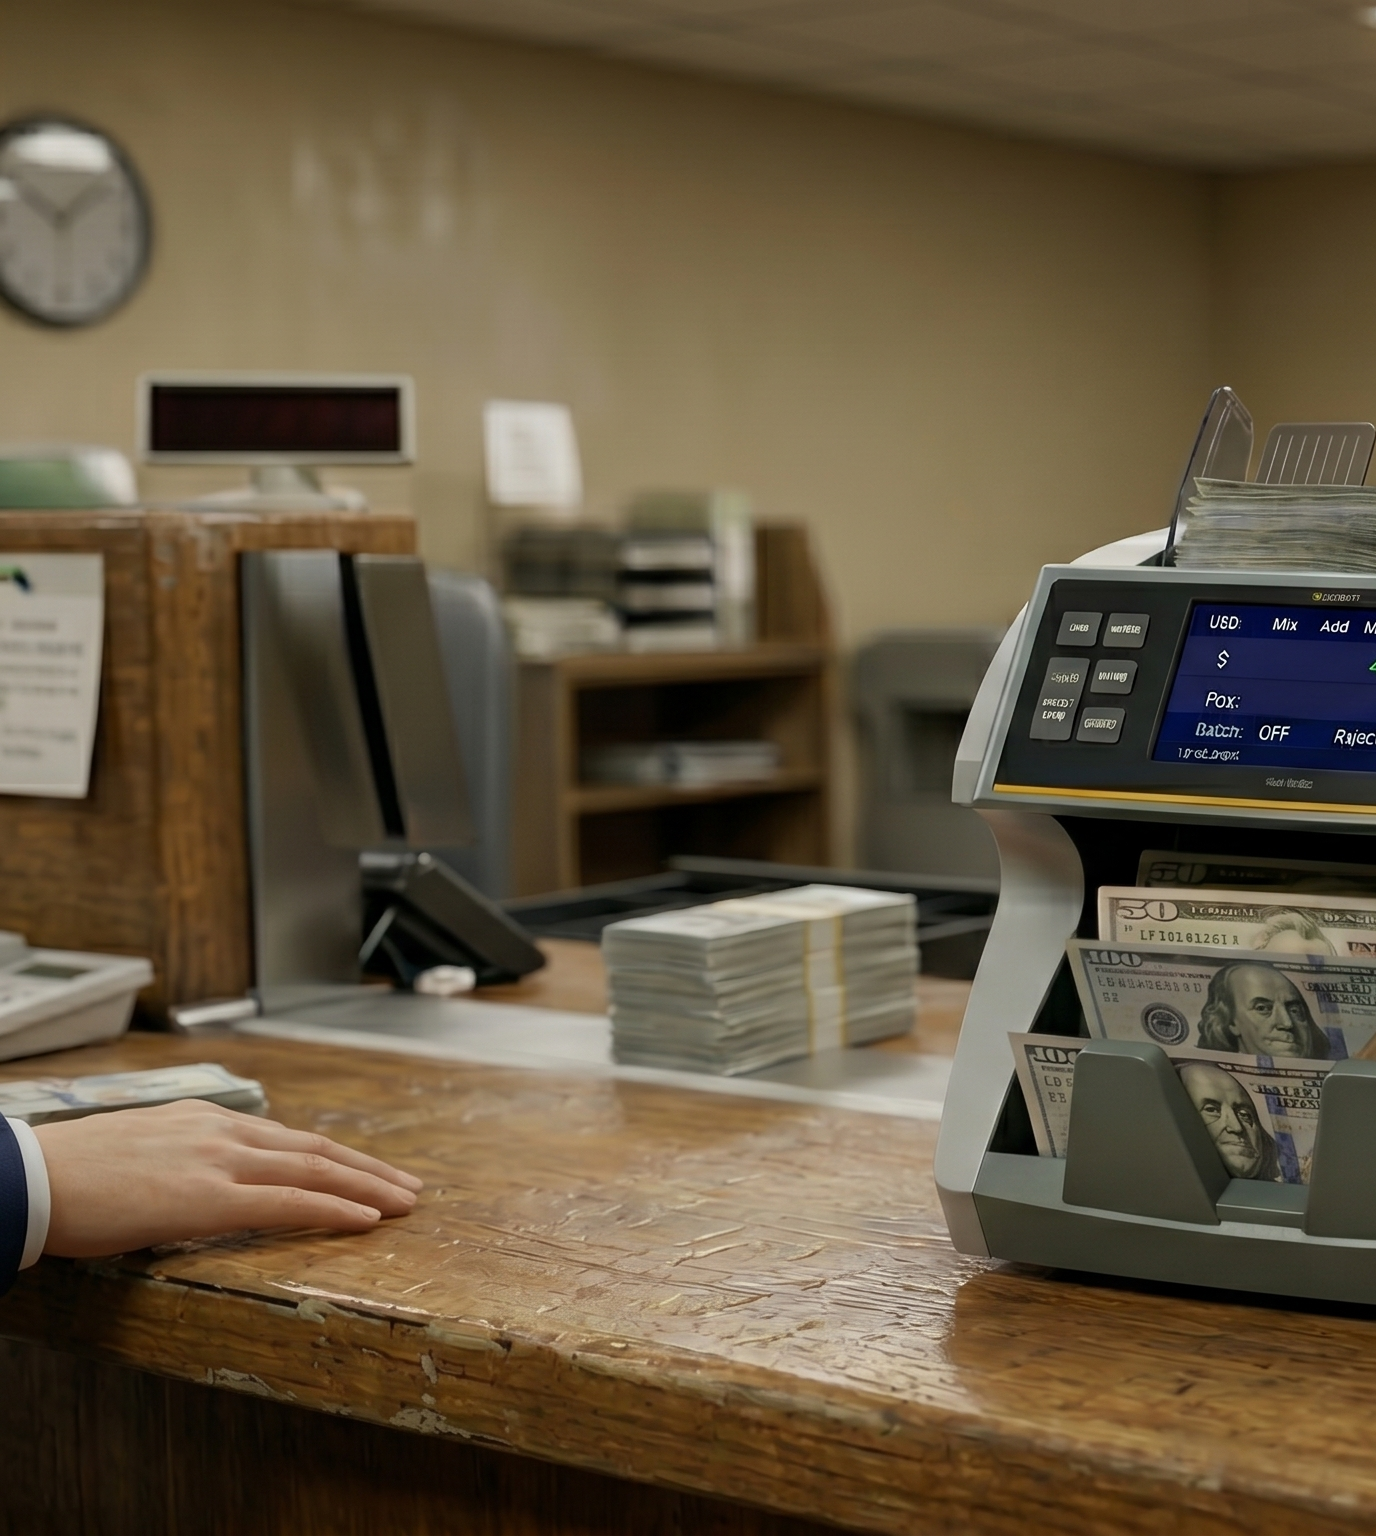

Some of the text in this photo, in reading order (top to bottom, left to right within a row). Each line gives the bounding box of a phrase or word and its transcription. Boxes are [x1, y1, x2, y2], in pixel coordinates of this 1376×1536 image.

[1272, 617, 1299, 632] Mix
[1319, 620, 1351, 634] Add
[1258, 724, 1291, 742] OFF
[1116, 899, 1180, 922] 50
[1086, 950, 1143, 968] 100
